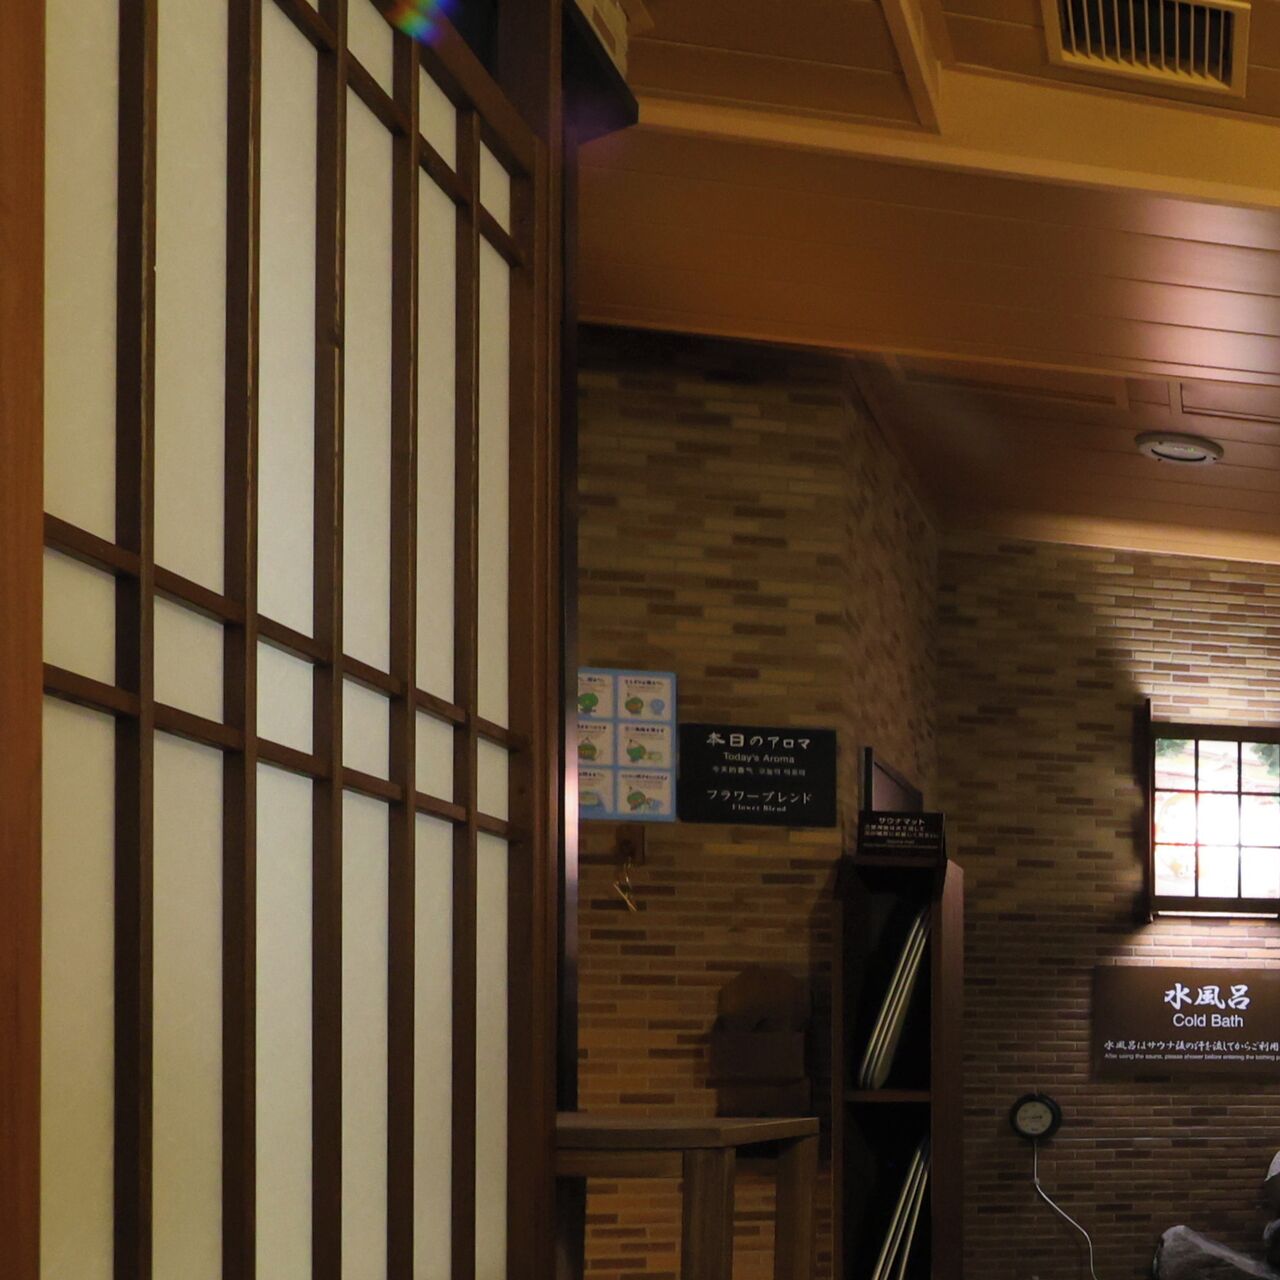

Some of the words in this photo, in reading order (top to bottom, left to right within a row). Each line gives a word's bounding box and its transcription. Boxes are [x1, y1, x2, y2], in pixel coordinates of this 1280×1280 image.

[706, 731, 811, 750] 本日のアロマ
[723, 752, 760, 764] Today's
[763, 754, 795, 764] Aroma
[707, 789, 812, 804] フラワーブレンド
[732, 803, 760, 812] Flower
[763, 804, 787, 812] Blend
[879, 817, 925, 825] サウナマット
[1163, 982, 1251, 1010] 水風呂
[1173, 1013, 1207, 1027] Cold
[1211, 1014, 1244, 1028] Bath
